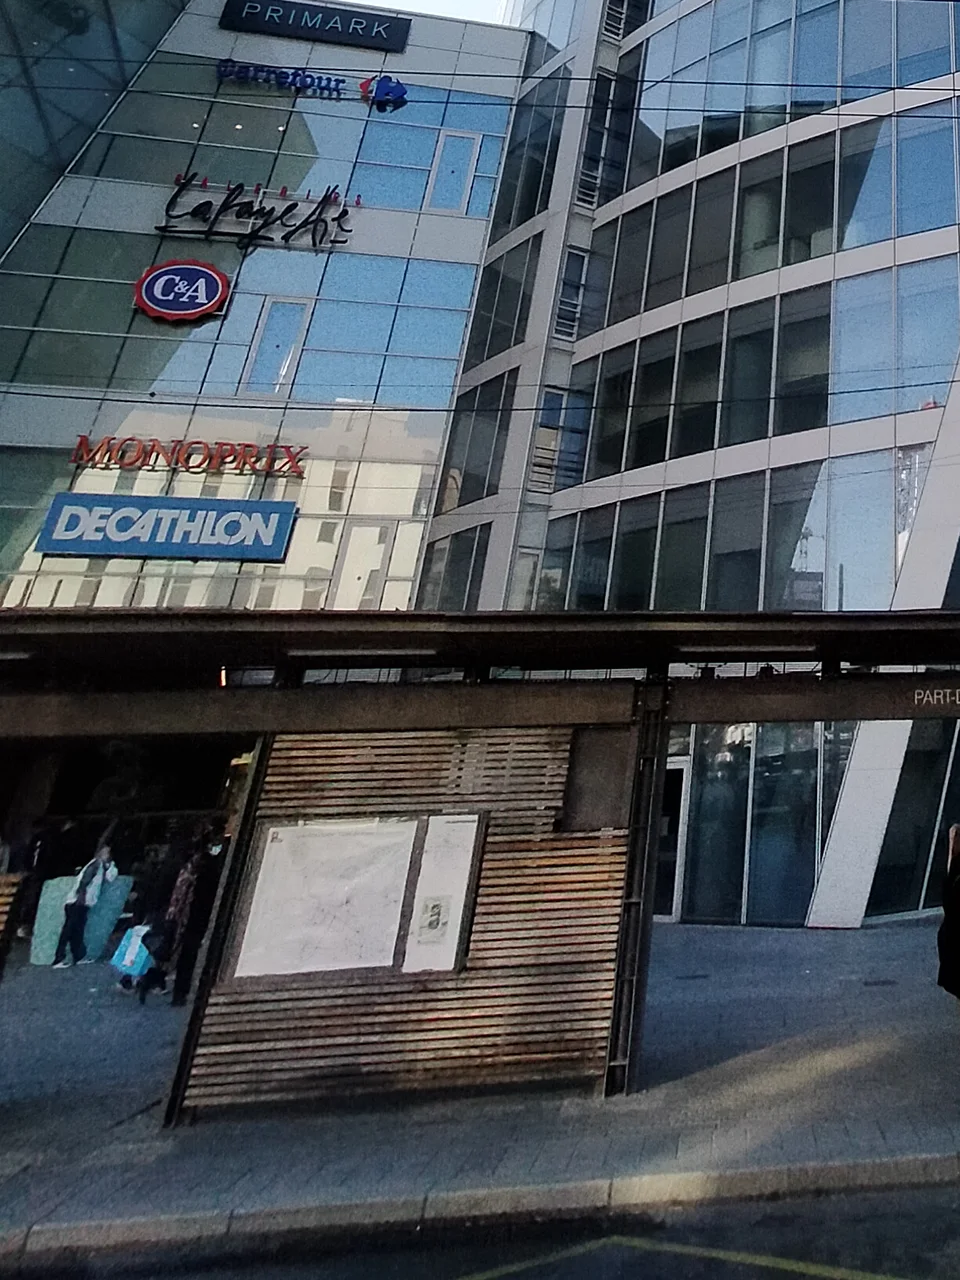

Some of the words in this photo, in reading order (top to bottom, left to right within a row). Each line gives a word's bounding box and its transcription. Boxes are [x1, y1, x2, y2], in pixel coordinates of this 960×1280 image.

[241, 2, 391, 39] PRIMARK
[217, 58, 346, 93] Carrefour
[154, 172, 353, 251] Lafayette
[153, 274, 209, 304] C&A
[68, 434, 309, 479] MONOPRIX
[52, 505, 279, 546] DECATHLON
